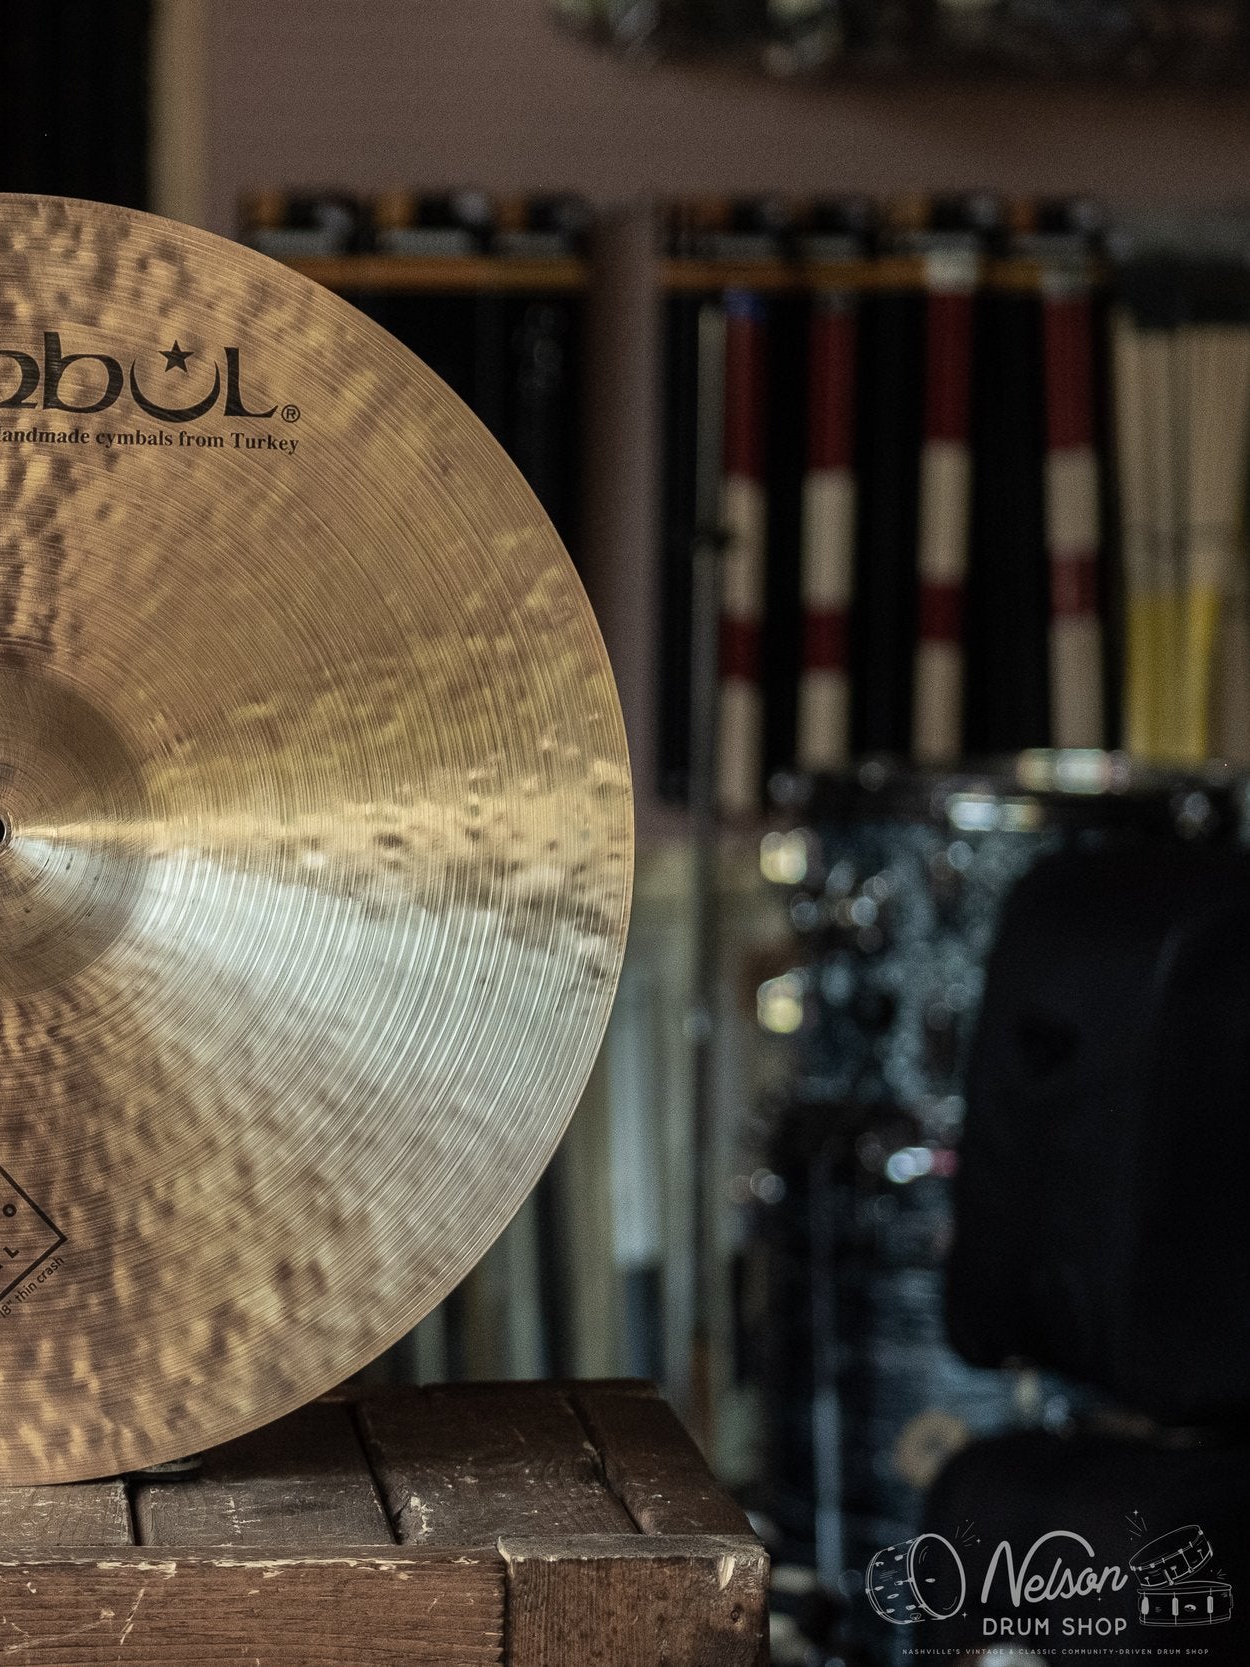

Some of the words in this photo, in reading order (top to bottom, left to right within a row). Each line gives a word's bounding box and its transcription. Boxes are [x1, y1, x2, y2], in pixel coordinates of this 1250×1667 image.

[95, 429, 174, 450] cymbals
[178, 431, 225, 449] from
[230, 432, 300, 455] Turkey
[14, 1281, 38, 1304] thin
[36, 1256, 65, 1284] crash
